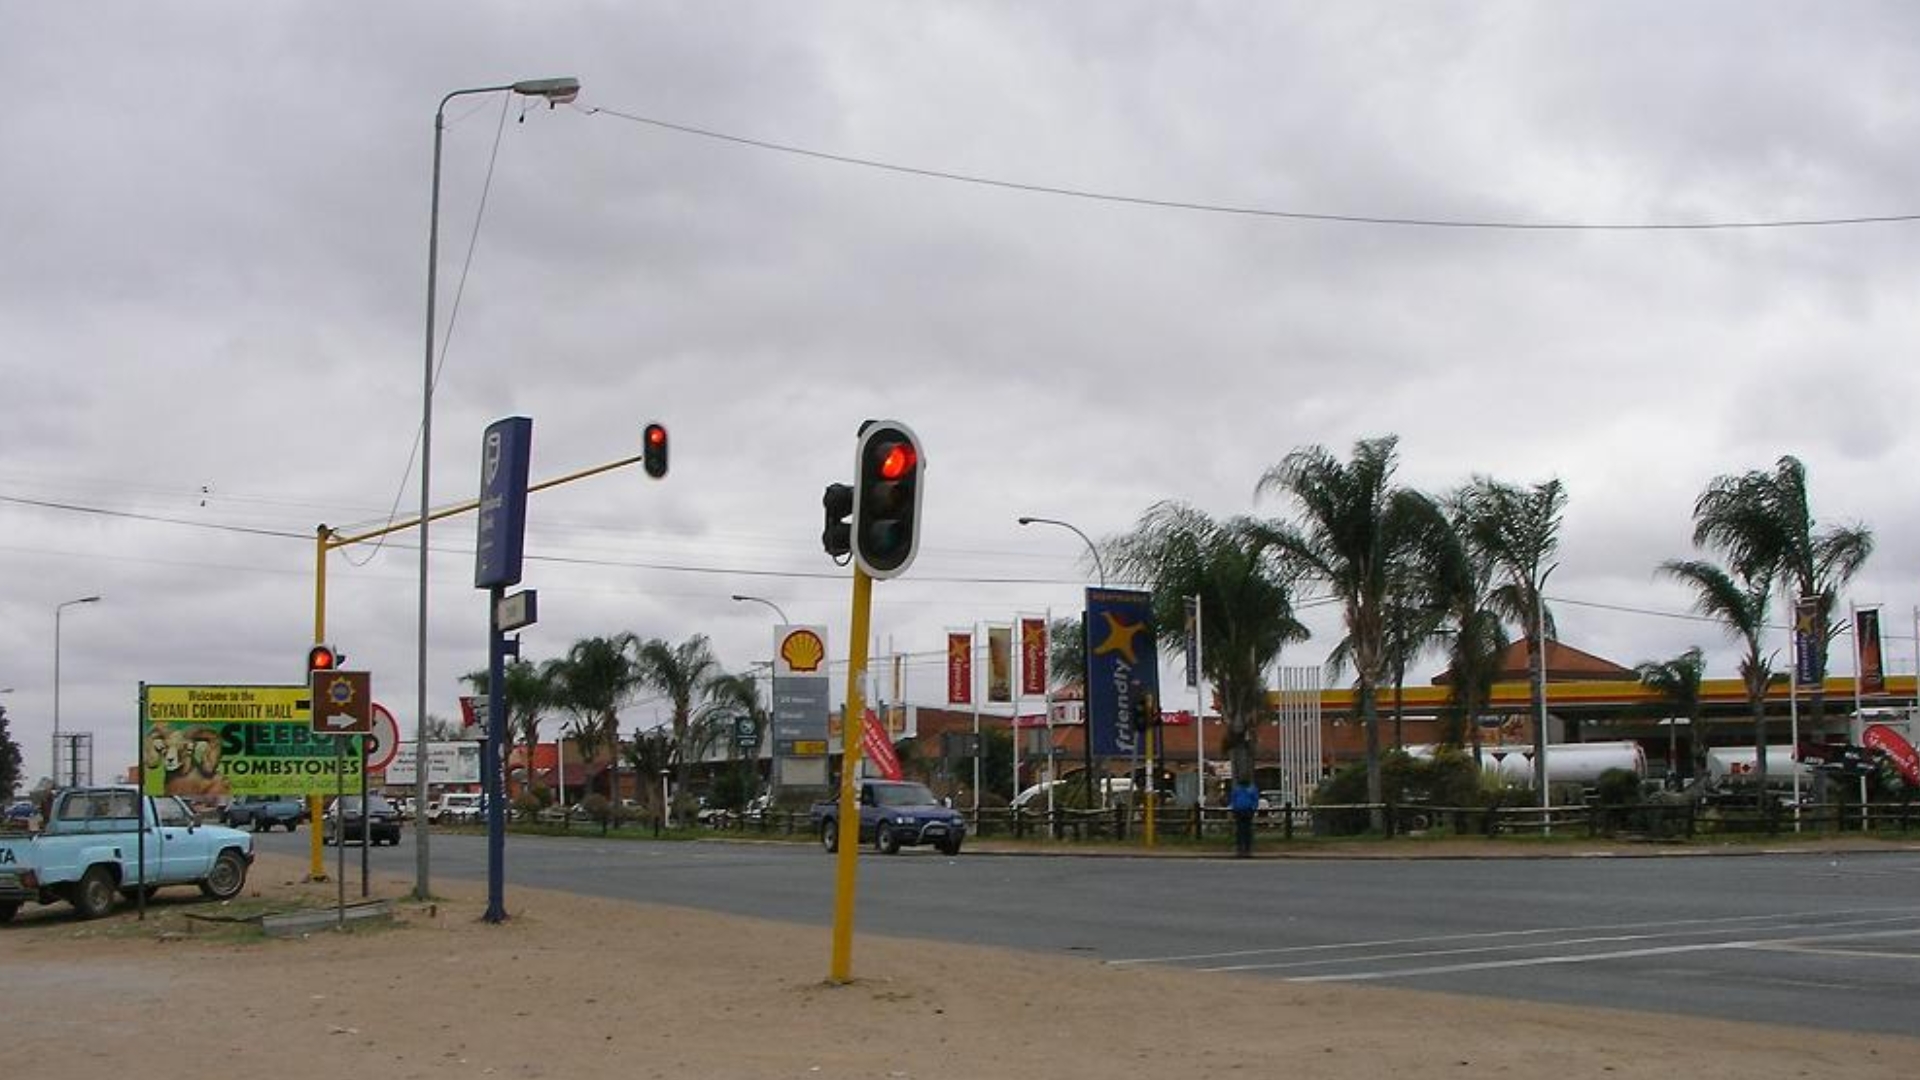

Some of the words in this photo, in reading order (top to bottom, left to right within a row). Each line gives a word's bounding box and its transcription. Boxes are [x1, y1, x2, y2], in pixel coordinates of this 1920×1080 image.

[189, 690, 227, 701] Welcome
[230, 691, 238, 701] to
[241, 690, 254, 701] the
[150, 703, 188, 718] GIYANI
[193, 703, 262, 718] COMMUNITY
[266, 703, 292, 718] HALL
[1114, 656, 1134, 752] friendly
[221, 760, 359, 775] TOMBSTONES
